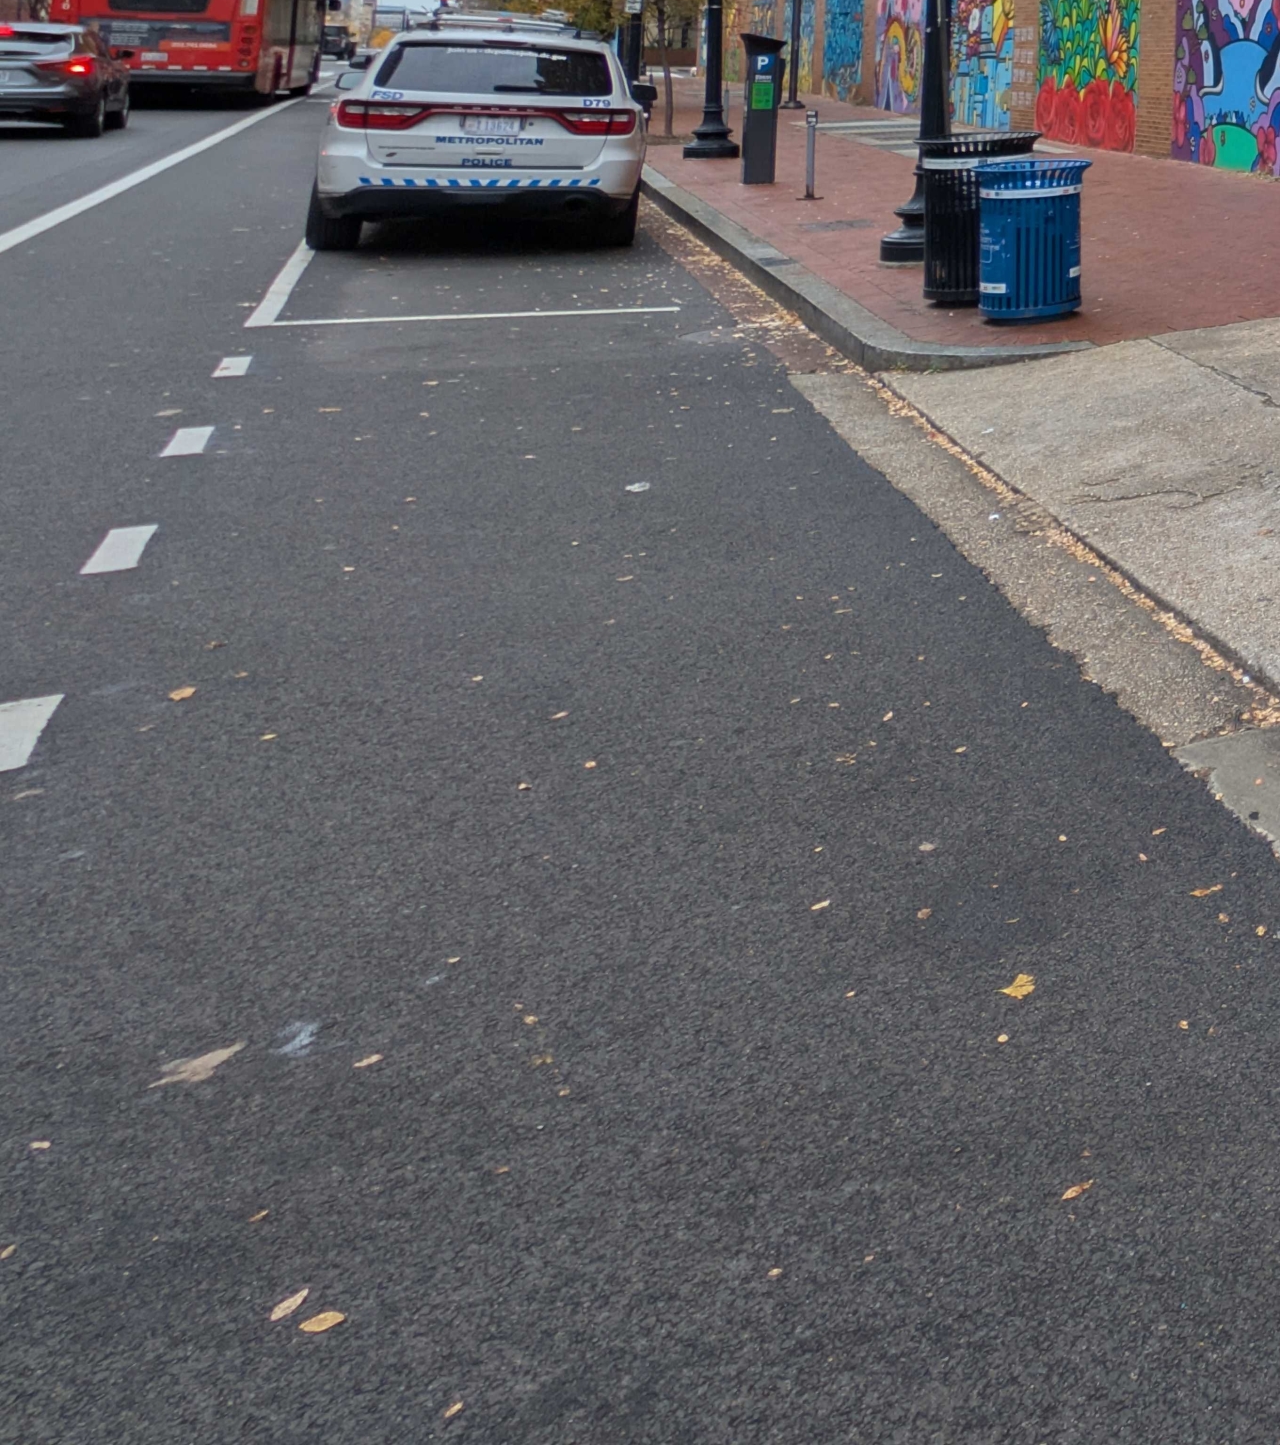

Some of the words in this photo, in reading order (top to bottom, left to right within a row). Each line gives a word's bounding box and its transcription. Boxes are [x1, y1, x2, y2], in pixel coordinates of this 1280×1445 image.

[757, 56, 769, 70] P
[371, 90, 404, 100] FSD
[582, 99, 611, 108] D79
[435, 136, 544, 146] METROPOLITAN
[461, 158, 513, 167] POLICE
